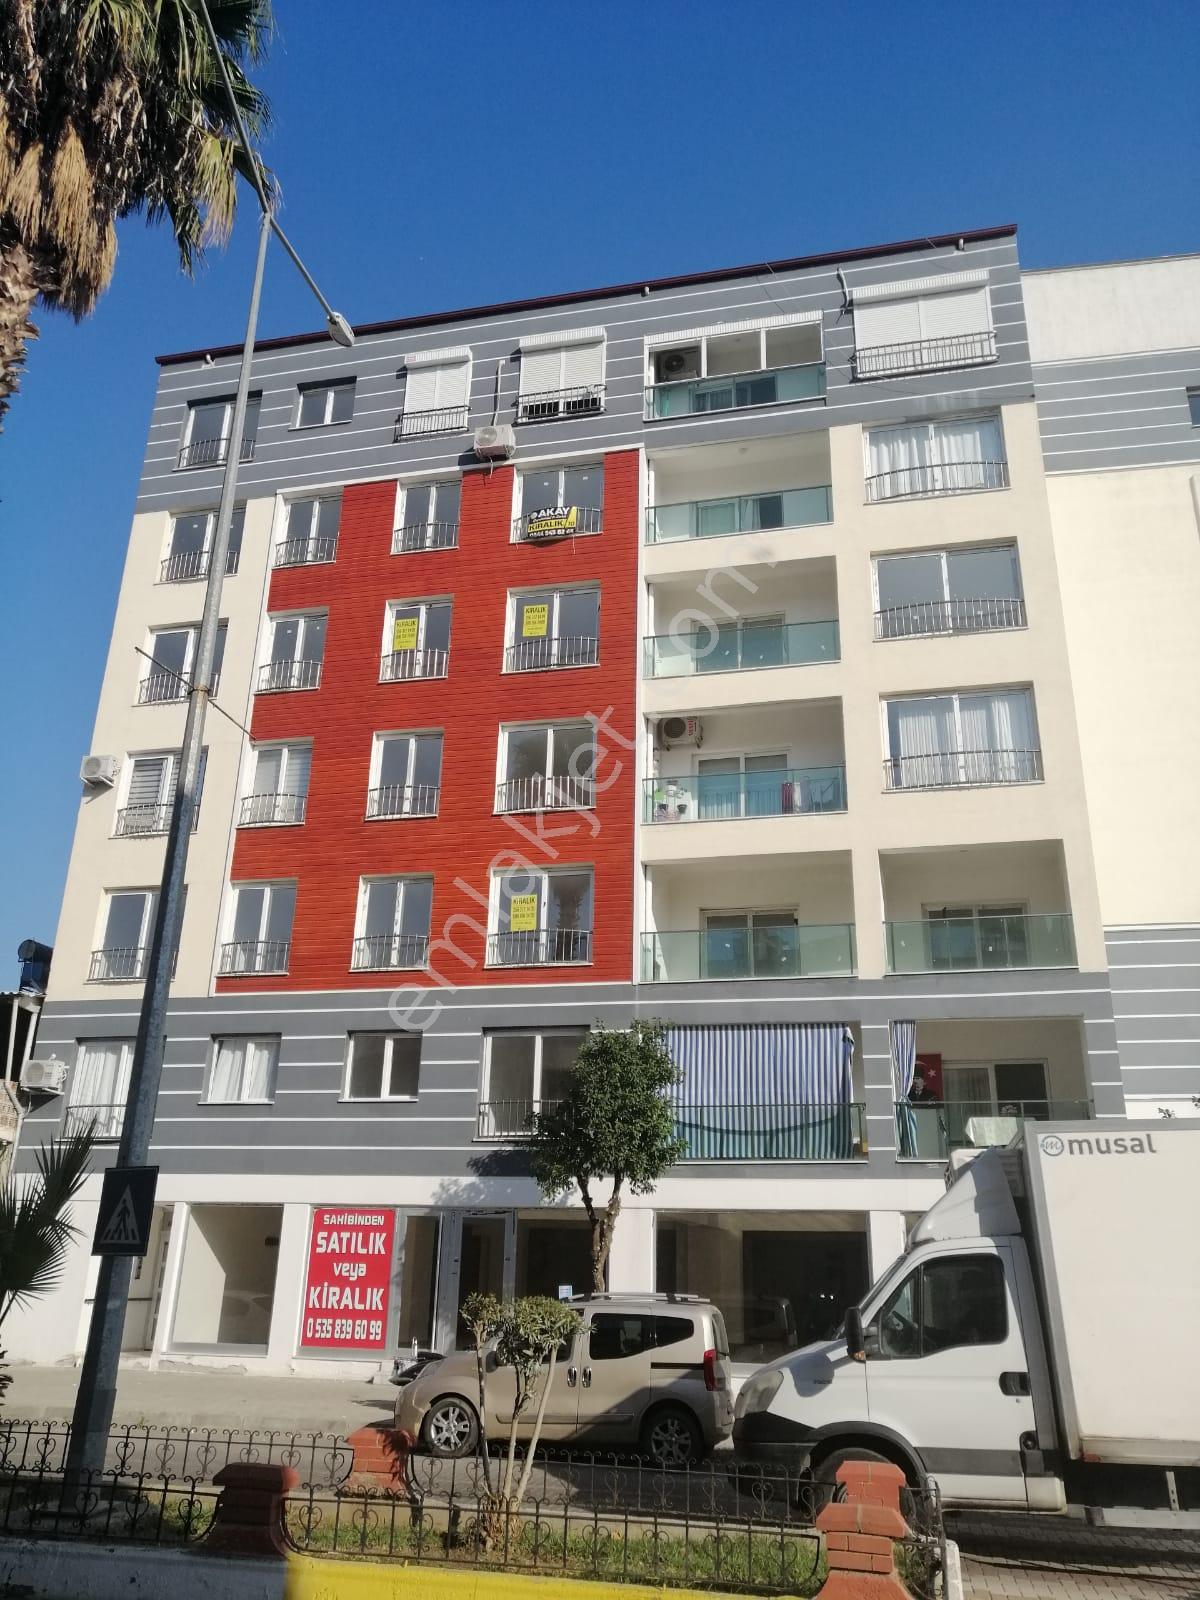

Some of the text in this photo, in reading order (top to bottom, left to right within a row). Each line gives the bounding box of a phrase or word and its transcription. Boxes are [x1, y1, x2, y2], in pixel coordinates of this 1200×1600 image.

[538, 507, 570, 518] AKAY
[1068, 1133, 1156, 1155] musal
[323, 1213, 385, 1226] SAHİBİNDEN
[315, 1231, 387, 1255] SATILIK
[333, 1262, 367, 1281] veya
[309, 1282, 384, 1311] KİRALIK
[307, 1318, 382, 1340] 0 535 839 60 99
